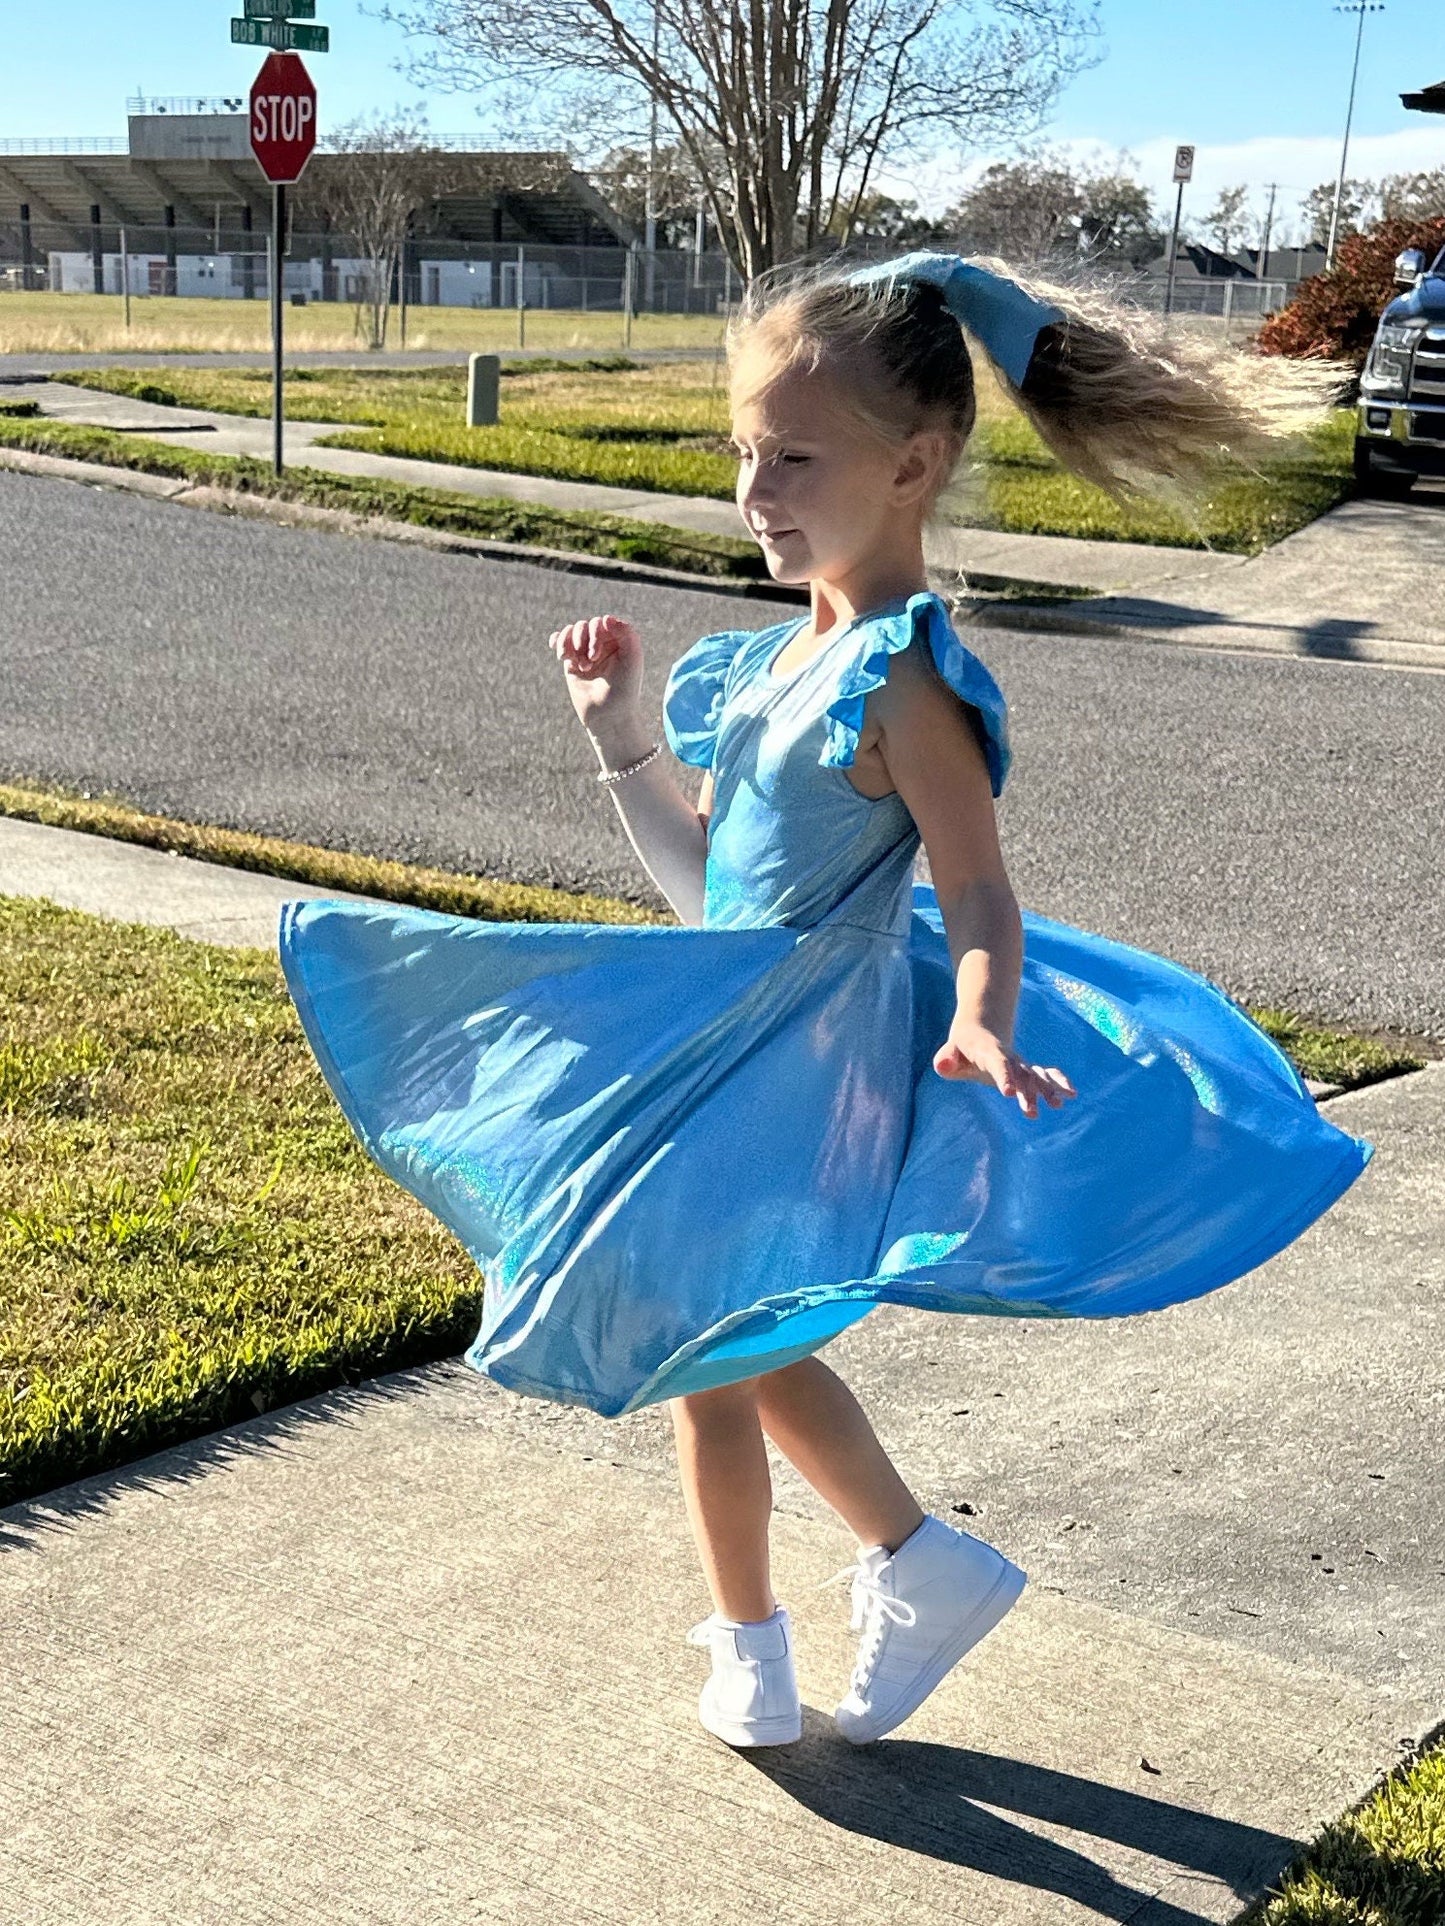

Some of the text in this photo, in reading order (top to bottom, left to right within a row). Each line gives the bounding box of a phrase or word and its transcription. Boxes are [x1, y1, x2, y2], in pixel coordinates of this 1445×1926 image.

[232, 21, 256, 43] BOB
[261, 23, 297, 47] WHITE
[253, 95, 313, 142] STOP
